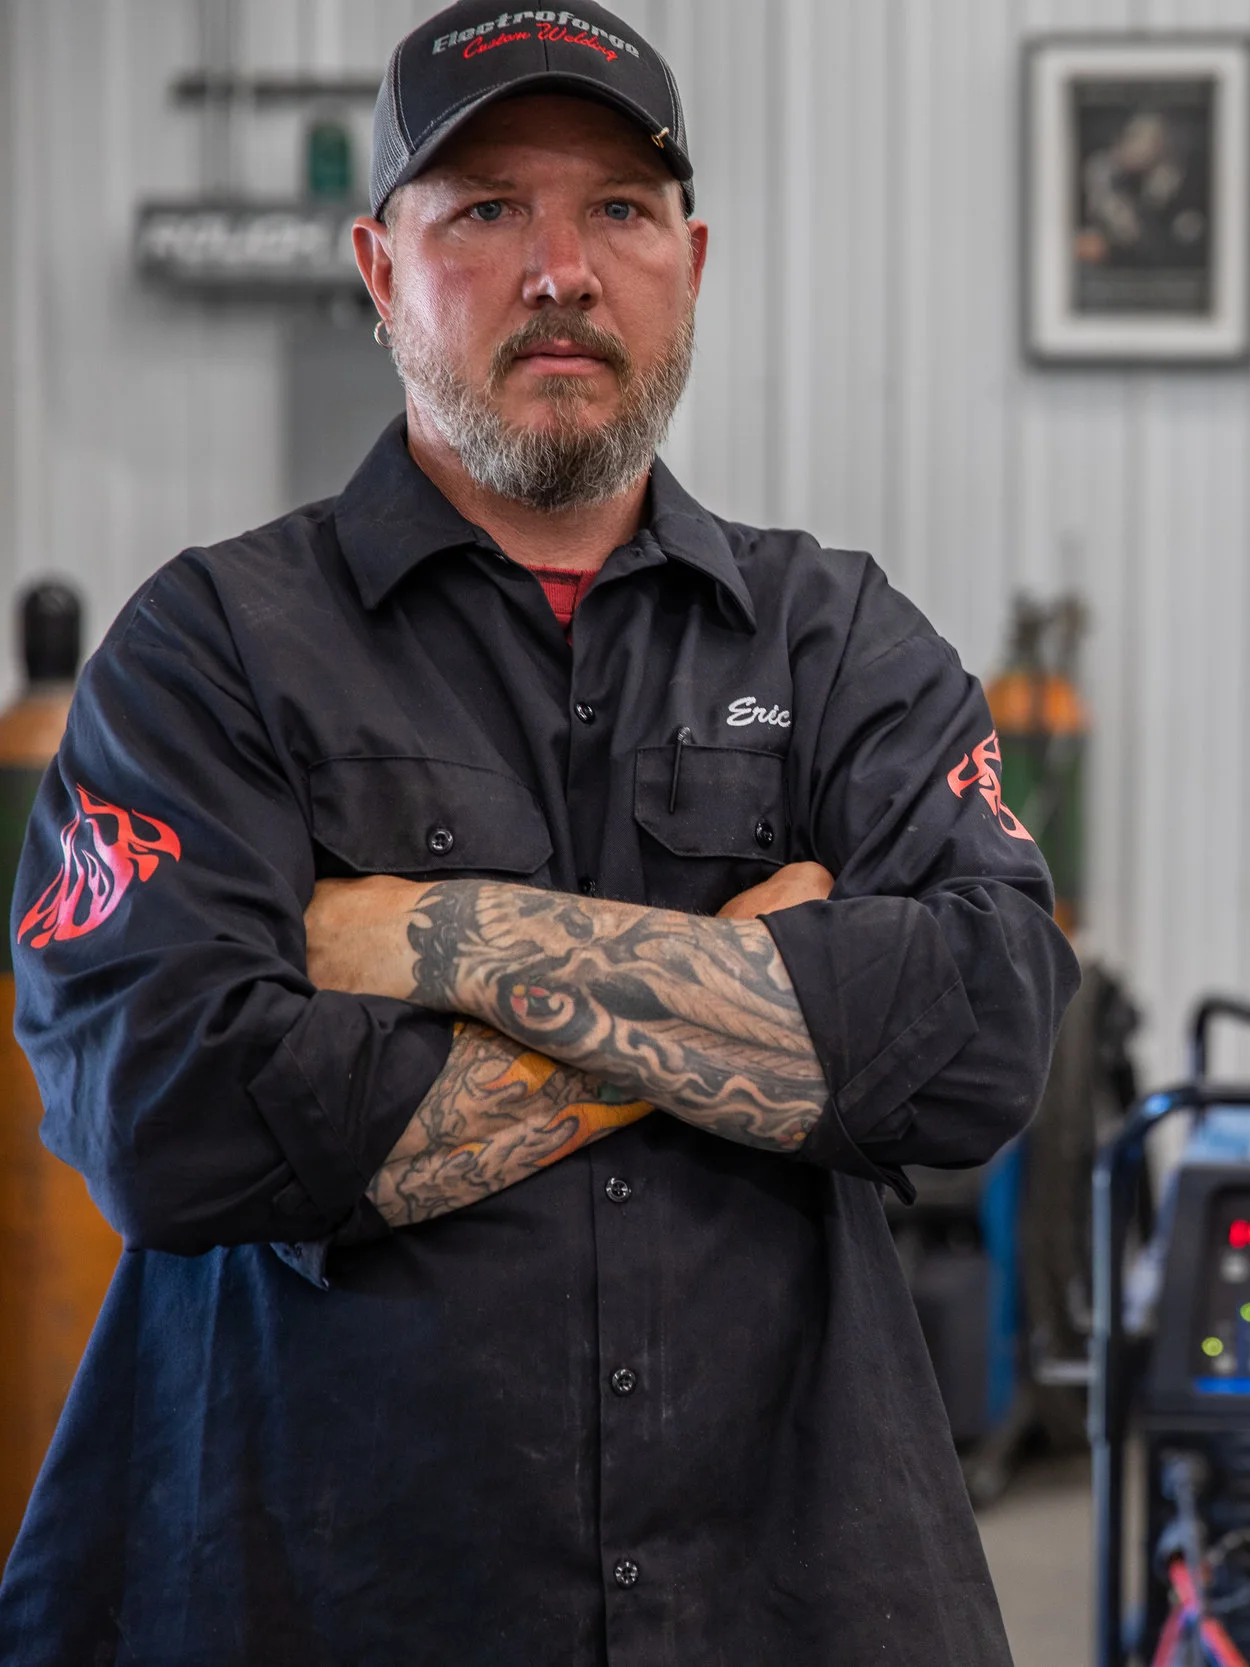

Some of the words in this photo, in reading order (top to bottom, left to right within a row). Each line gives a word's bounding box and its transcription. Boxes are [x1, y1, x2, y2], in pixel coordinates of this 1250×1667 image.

[432, 10, 640, 58] Electroforge
[463, 31, 531, 59] Custom
[536, 23, 618, 62] Welding
[726, 696, 791, 727] Eric
